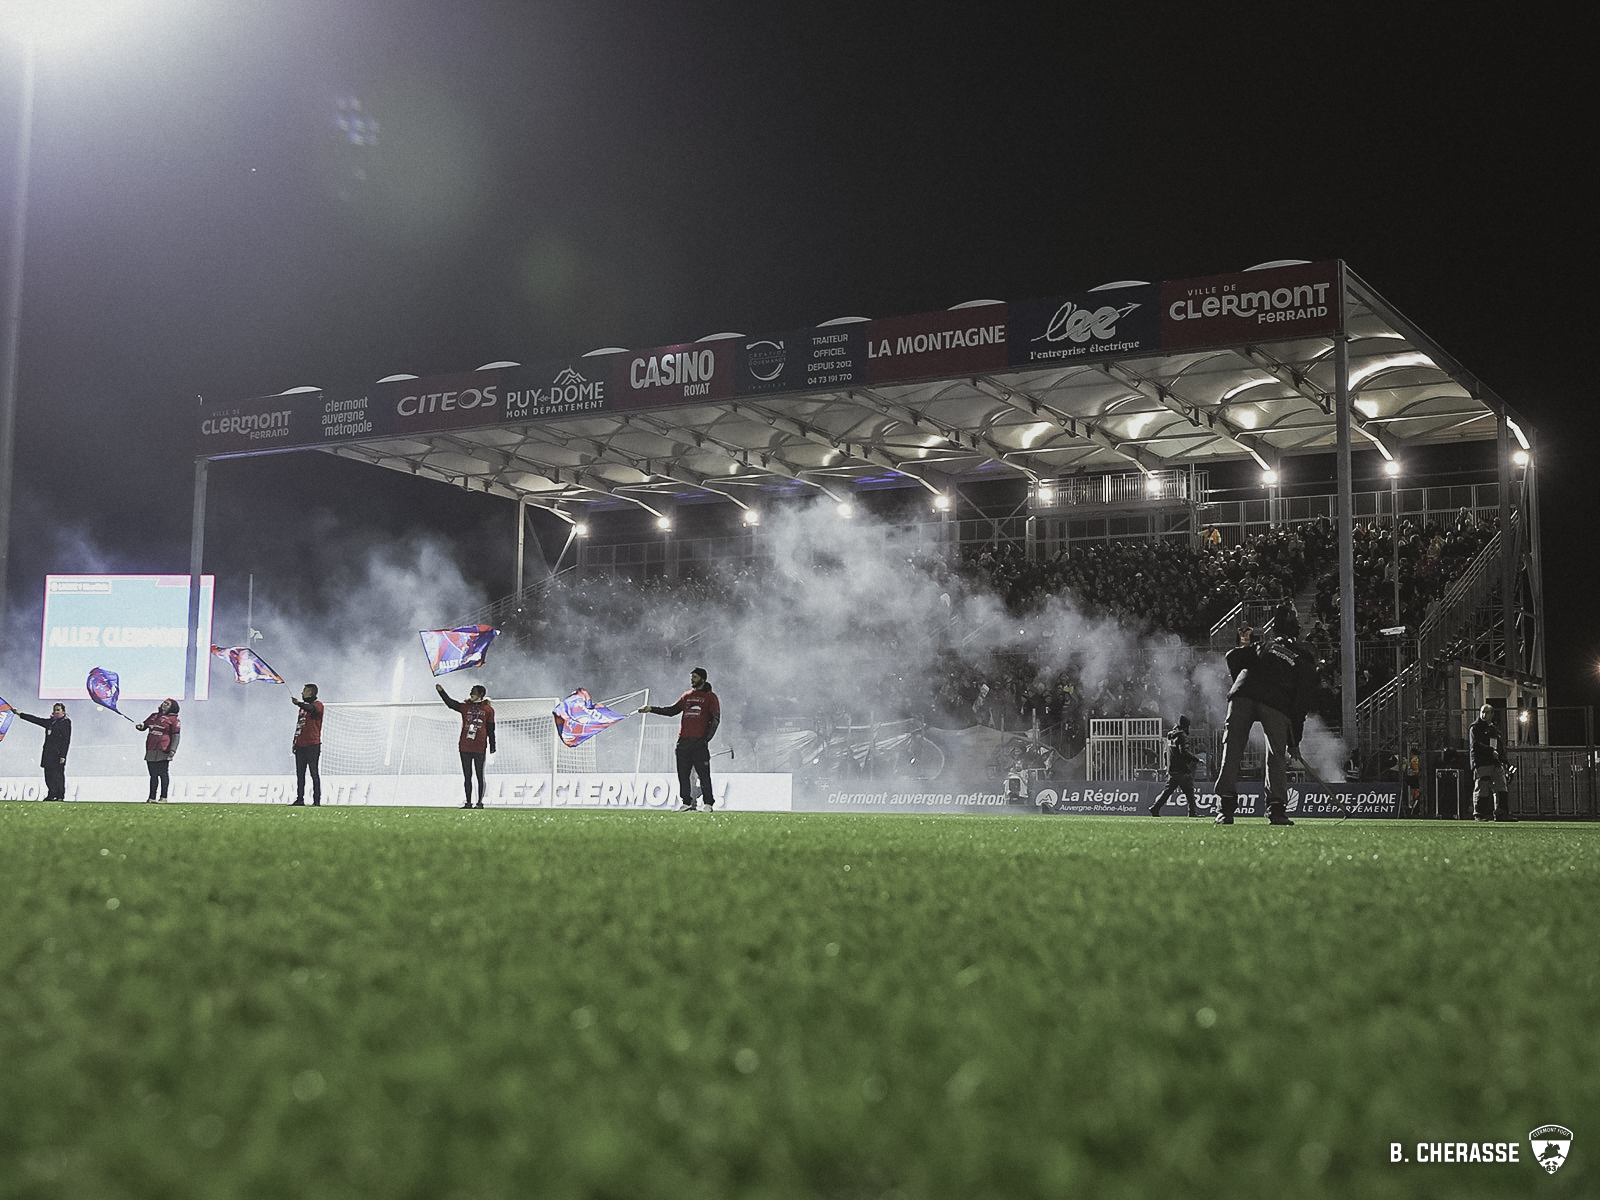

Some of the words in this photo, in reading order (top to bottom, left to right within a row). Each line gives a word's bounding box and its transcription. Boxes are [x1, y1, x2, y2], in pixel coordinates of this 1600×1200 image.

[1187, 286, 1217, 296] VILLE
[1223, 284, 1237, 292] DE
[812, 333, 849, 346] TRAITEUR
[867, 338, 892, 359] LA
[895, 324, 1006, 355] MONTAGNE
[813, 347, 847, 358] OFFICIEL
[1030, 346, 1086, 360] l'entreprise
[1089, 340, 1140, 354] électrique
[630, 349, 716, 389] CASINO
[807, 361, 835, 372] DEPUIS
[836, 360, 852, 369] 2012
[807, 377, 818, 385] 04
[819, 376, 827, 384] 73
[839, 373, 853, 381] 770
[683, 381, 710, 397] ROYAT
[325, 396, 368, 413] clermont
[396, 386, 498, 417] CITEOS
[506, 408, 528, 418] MON
[532, 400, 604, 416] DÉPARTEMENT
[321, 410, 365, 426] auvergne
[324, 420, 373, 438] métropole
[48, 626, 100, 647] ALLEZ
[827, 790, 888, 805] clermont
[889, 792, 953, 807] auvergne
[1061, 789, 1079, 802] La
[1083, 788, 1140, 805] Région
[1304, 790, 1397, 805] PUY-DE-DÔME
[1059, 804, 1137, 813] Auvergne-Rhône-Alpes
[1302, 805, 1314, 813] LE
